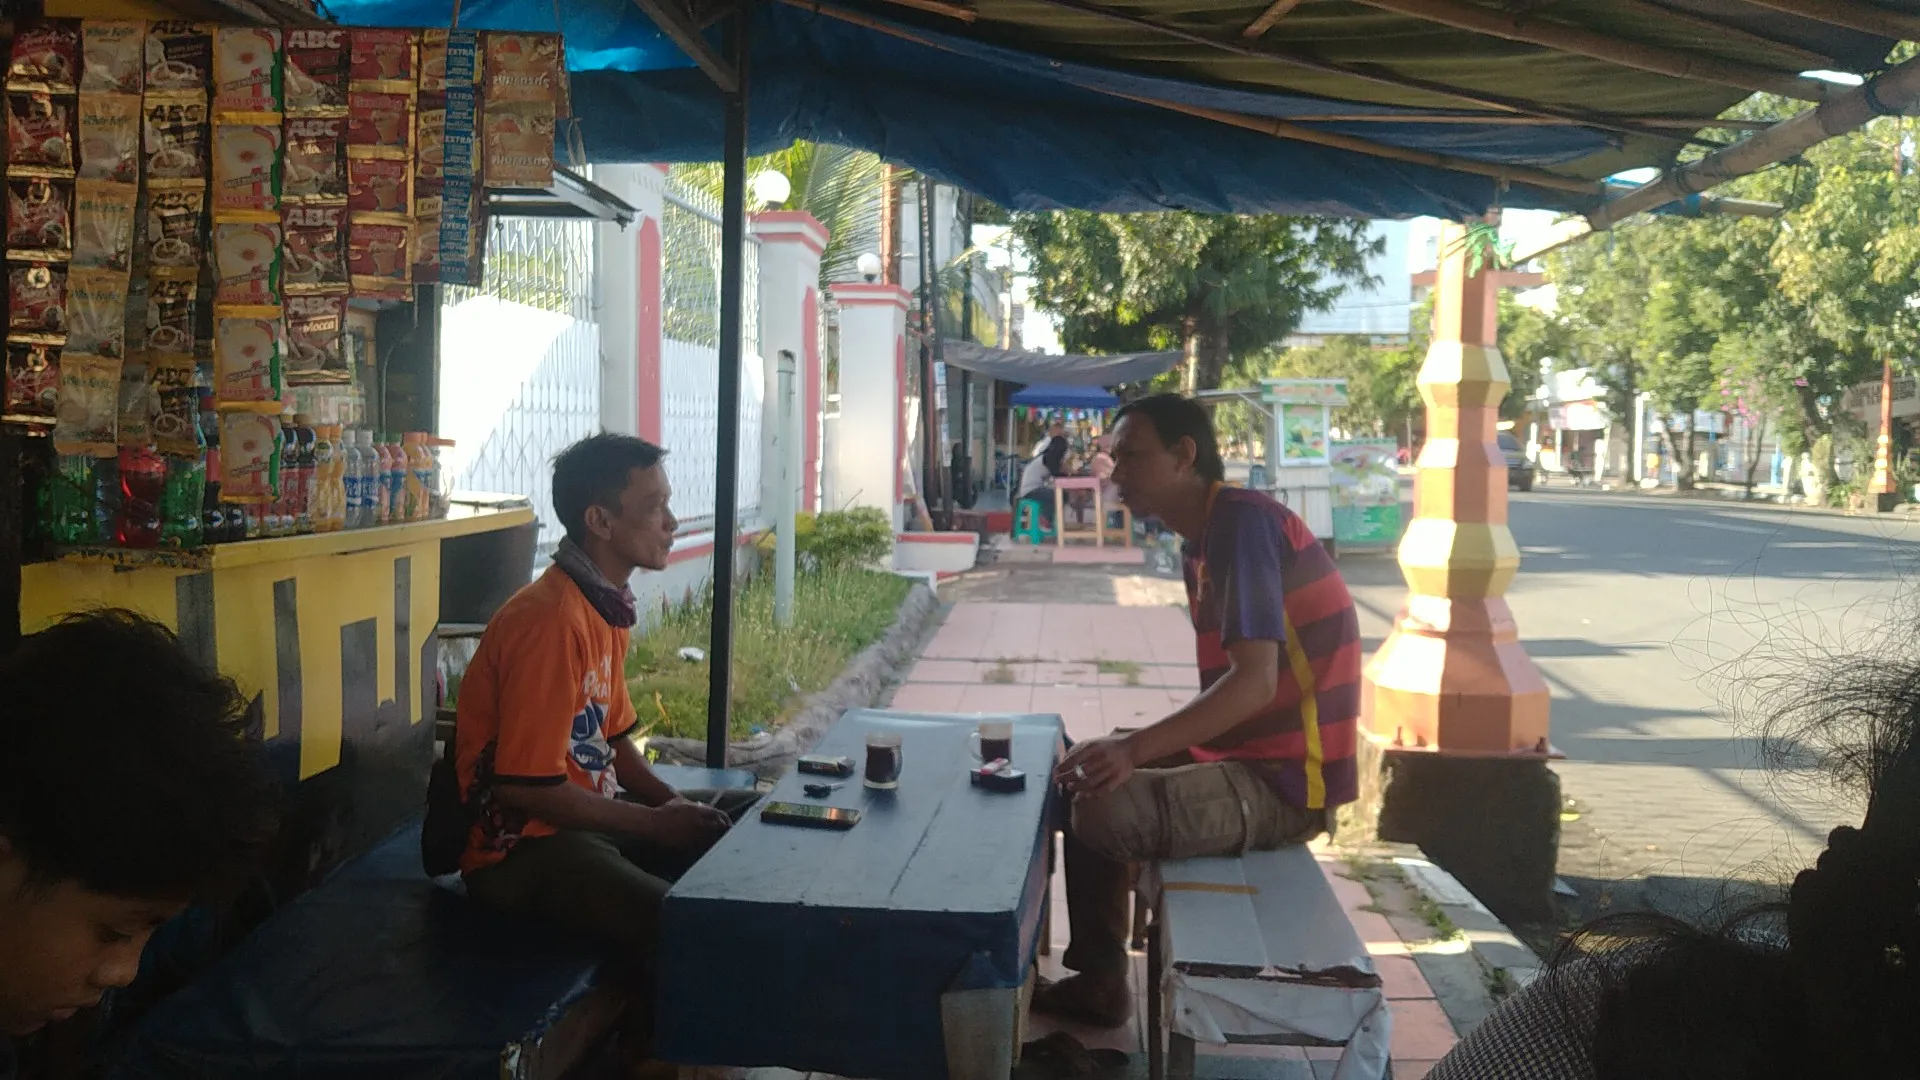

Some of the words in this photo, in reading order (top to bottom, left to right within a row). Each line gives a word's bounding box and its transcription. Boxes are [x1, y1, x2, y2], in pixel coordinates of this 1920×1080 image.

[150, 20, 203, 34] ABC
[288, 30, 342, 49] ABC
[448, 48, 474, 56] EXTRA
[149, 104, 203, 122] ABC
[288, 120, 340, 137] ABC
[445, 135, 471, 144] EXTRA
[287, 208, 340, 227] ABC
[152, 280, 194, 298] ABC
[288, 297, 341, 316] ABC
